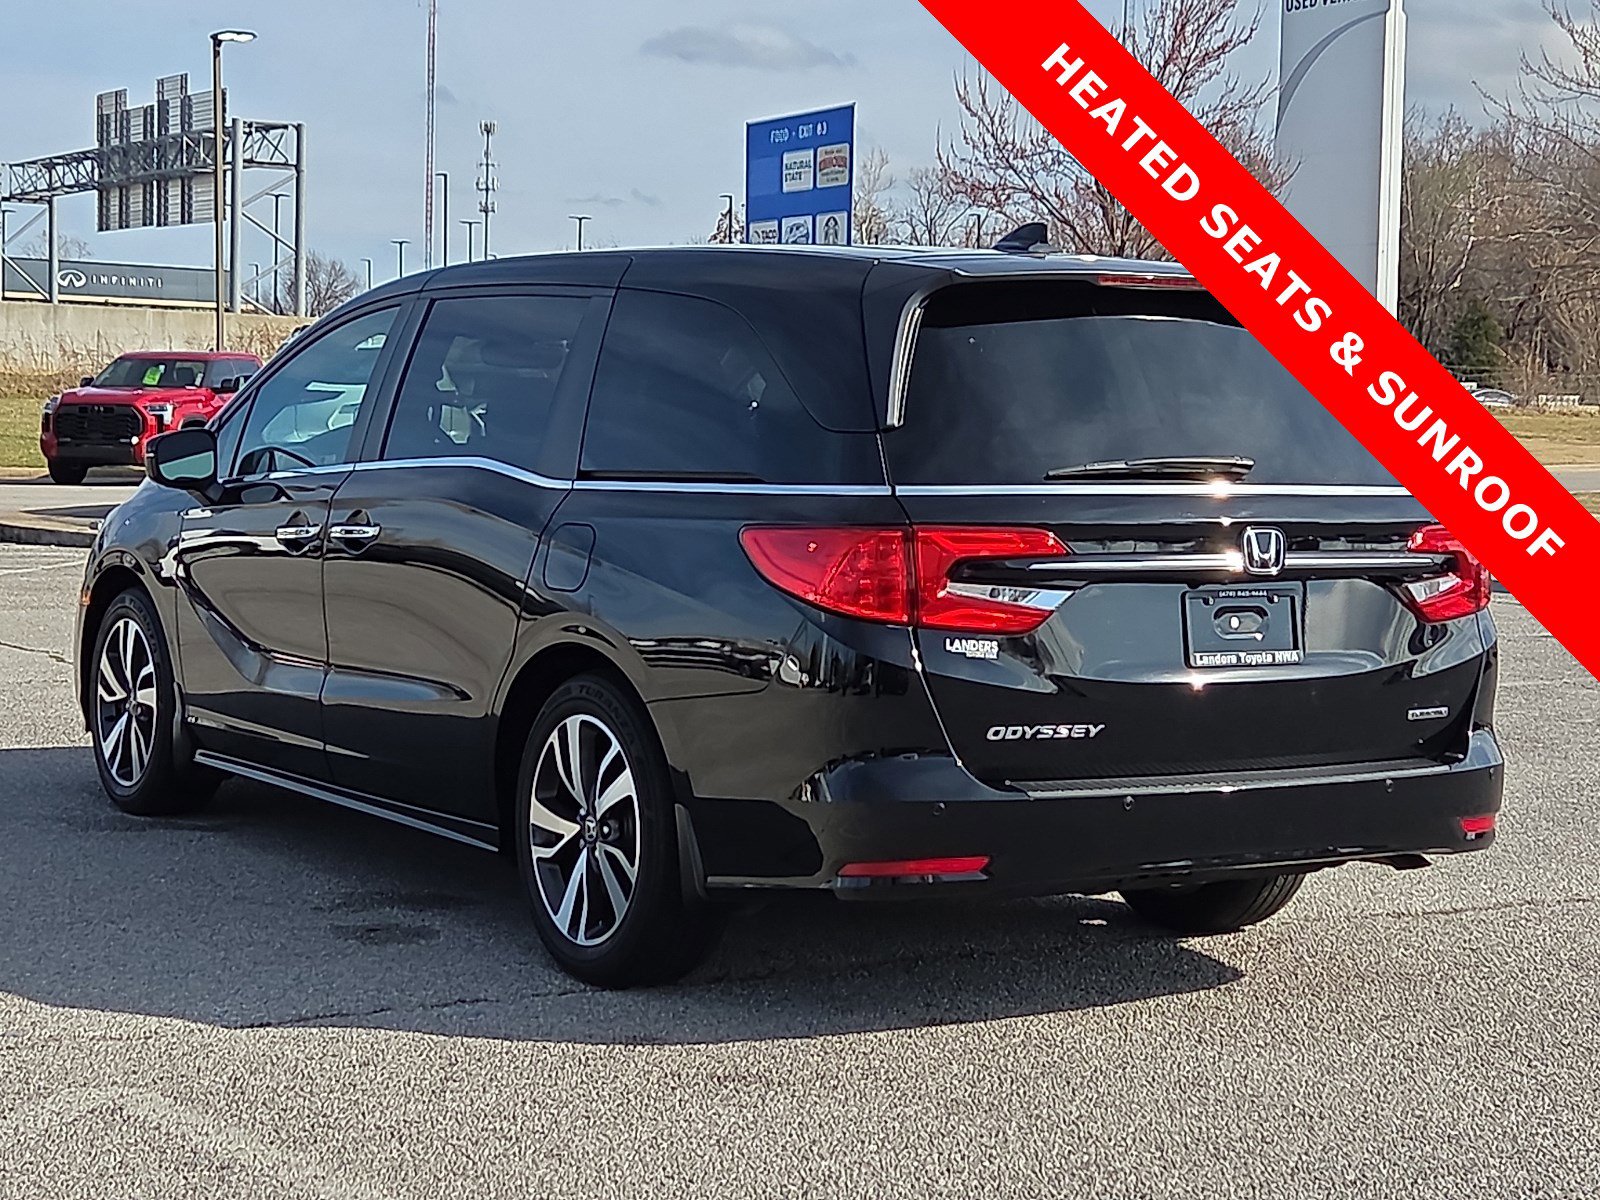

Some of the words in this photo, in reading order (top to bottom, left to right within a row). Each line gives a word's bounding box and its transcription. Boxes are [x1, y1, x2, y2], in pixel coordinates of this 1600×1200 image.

[784, 159, 812, 170] NATURAL
[784, 171, 802, 182] STATE
[92, 273, 162, 289] INFINITI
[945, 638, 999, 652] LANDERS
[1194, 653, 1237, 666] Landers
[1238, 652, 1273, 666] Toyota
[1274, 650, 1300, 663] NWA
[986, 724, 1106, 741] ODYSSEY
